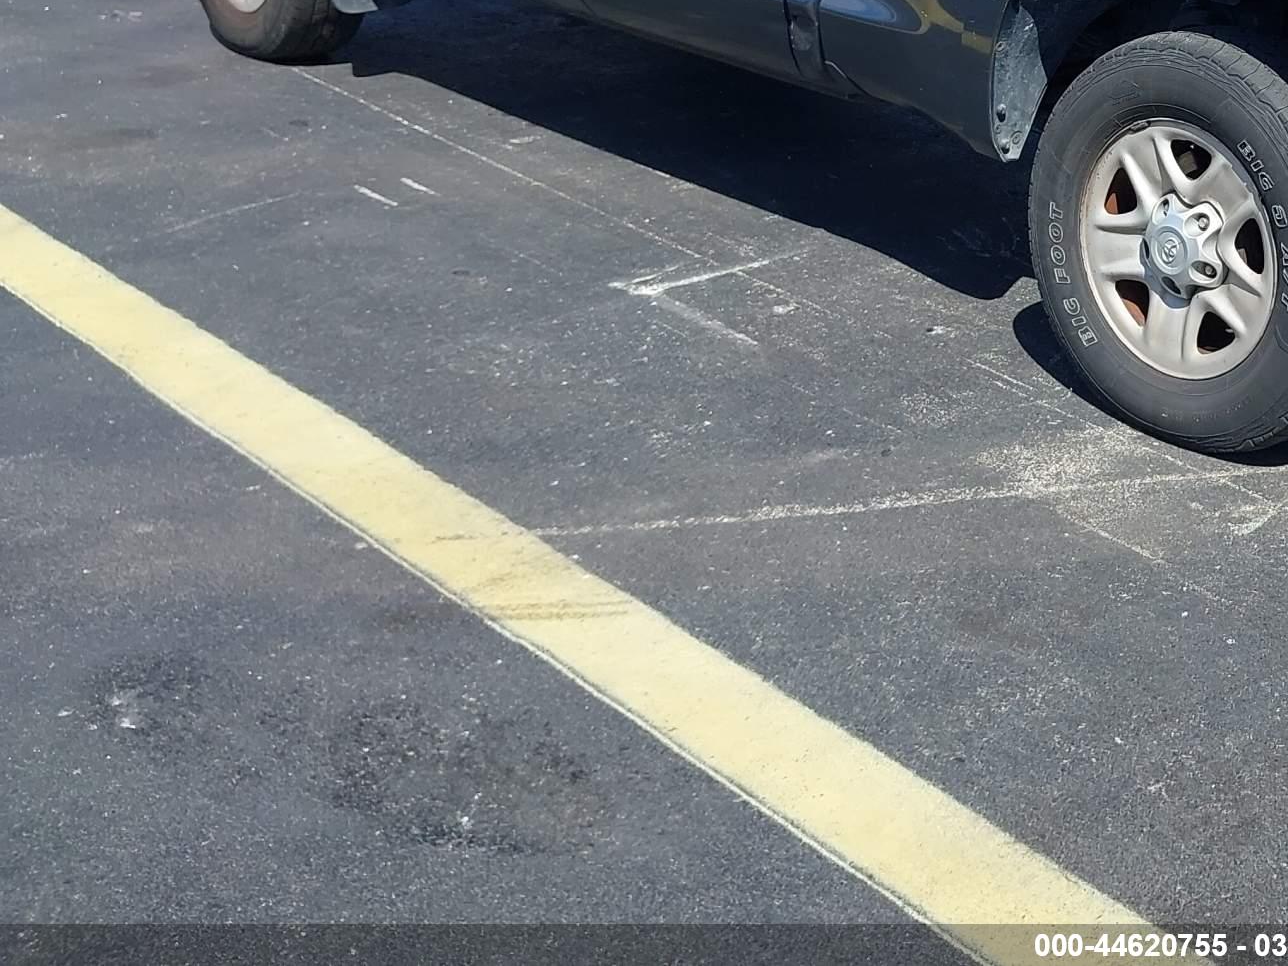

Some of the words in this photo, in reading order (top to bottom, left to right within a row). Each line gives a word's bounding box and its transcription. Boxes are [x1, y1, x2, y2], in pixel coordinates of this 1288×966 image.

[1237, 139, 1275, 191] BIG
[1048, 201, 1071, 284] FOOT
[1063, 297, 1098, 347] BIG
